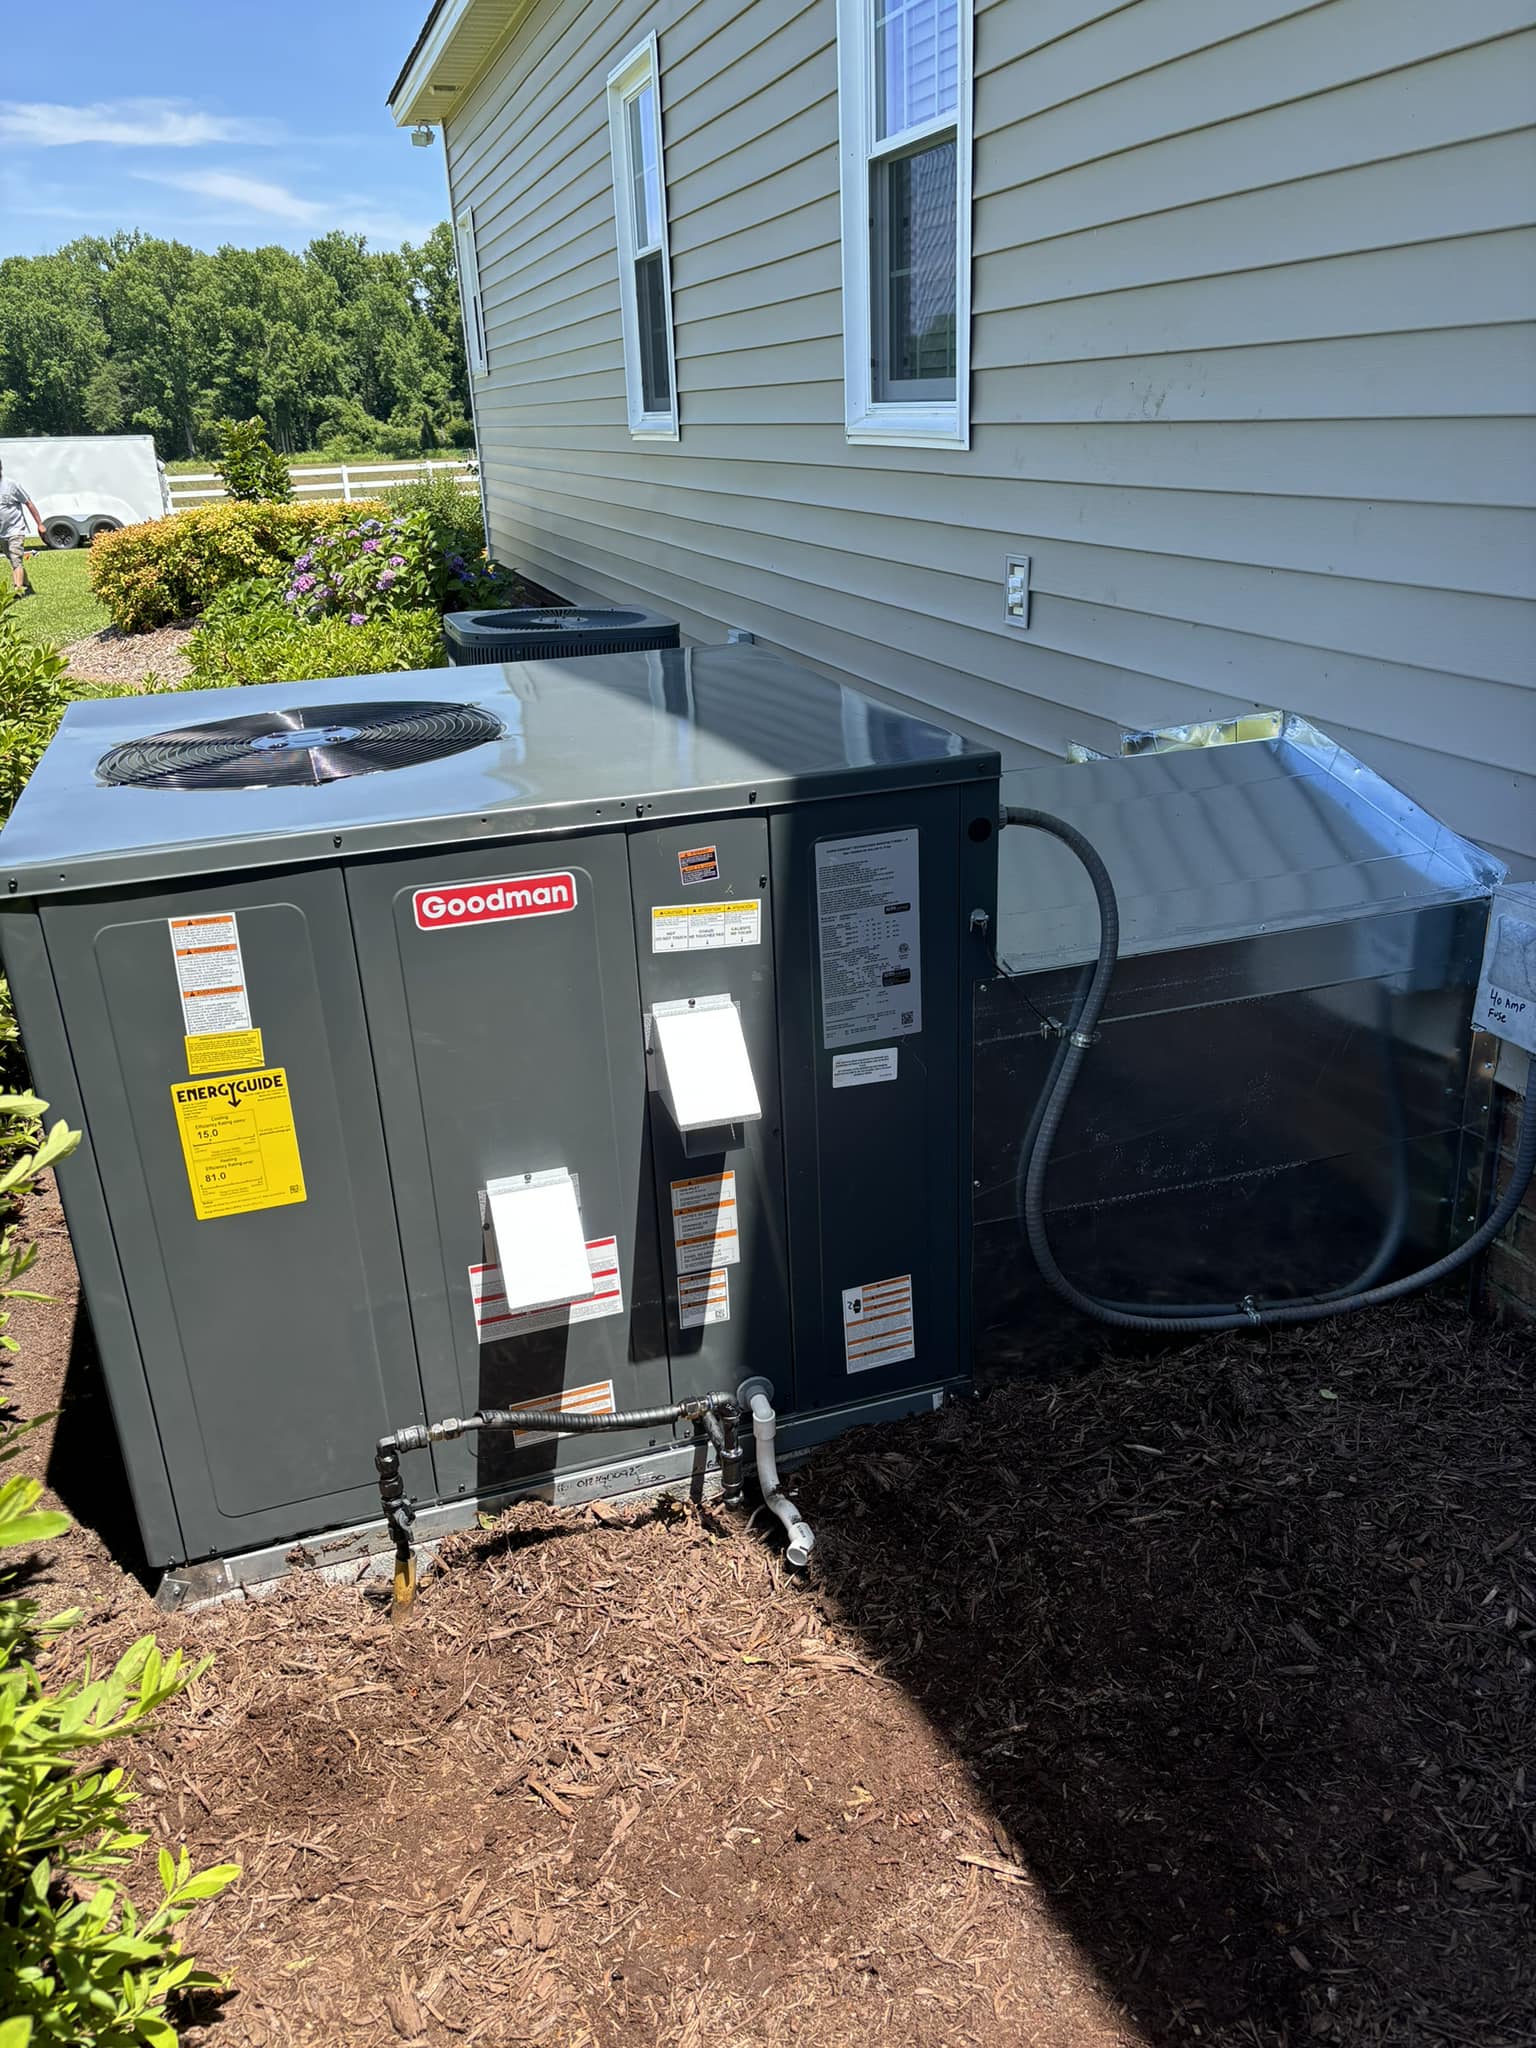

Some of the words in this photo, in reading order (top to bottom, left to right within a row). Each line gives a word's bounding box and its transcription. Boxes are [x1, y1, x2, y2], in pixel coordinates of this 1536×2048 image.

[422, 884, 569, 919] Goodman
[176, 1075, 283, 1105] ENERGYGUIDE
[197, 1128, 219, 1139] 15.0
[204, 1171, 227, 1183] 81.0
